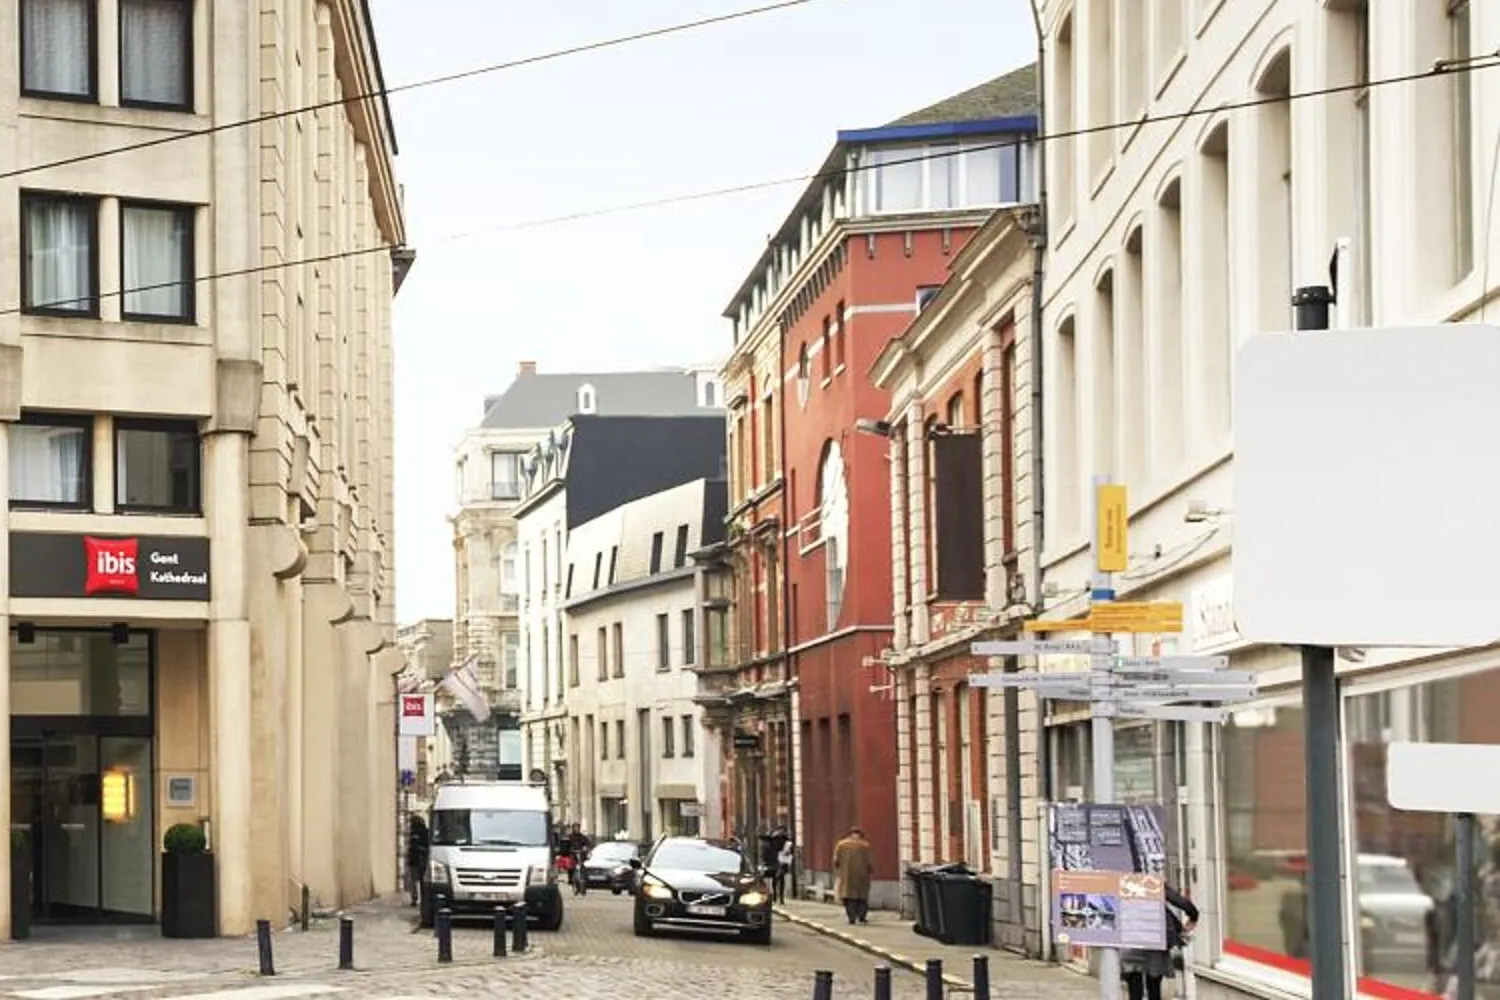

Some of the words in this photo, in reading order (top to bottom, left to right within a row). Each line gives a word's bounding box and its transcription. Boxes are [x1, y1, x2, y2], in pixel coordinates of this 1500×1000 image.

[97, 551, 136, 575] ibis
[150, 551, 180, 565] Gent
[150, 571, 208, 584] Kathedraal
